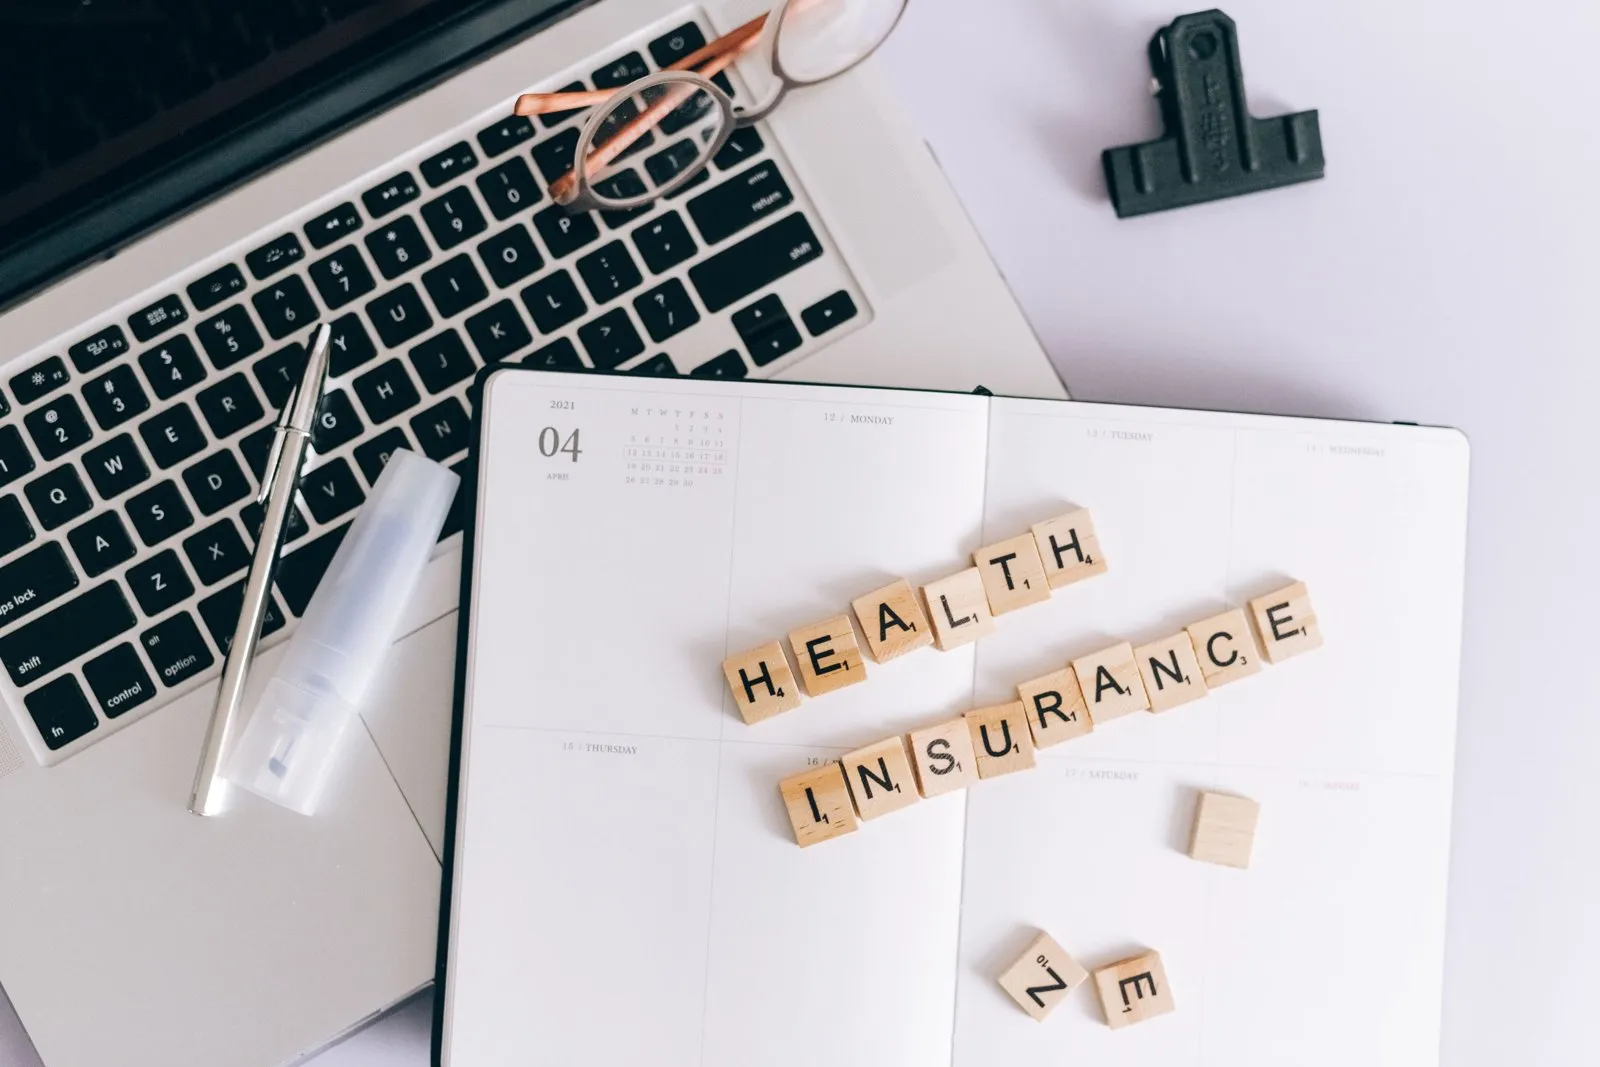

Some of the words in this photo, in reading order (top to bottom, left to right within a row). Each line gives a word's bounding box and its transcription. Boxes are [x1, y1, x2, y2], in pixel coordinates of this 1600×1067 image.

[507, 189, 520, 203] 0
[752, 191, 782, 212] return
[452, 218, 463, 232] 9
[558, 218, 571, 234] P
[396, 247, 408, 262] 8
[502, 247, 518, 263] O
[789, 241, 812, 260] shift
[329, 260, 343, 275] &
[339, 276, 349, 292] 7
[547, 295, 561, 309] L
[285, 307, 296, 321] 6
[389, 305, 406, 322] U
[214, 319, 231, 334] %
[490, 322, 506, 339] K
[227, 337, 239, 352] 5
[334, 335, 347, 351] Y
[160, 350, 172, 365] $
[439, 353, 448, 368] J
[172, 367, 182, 381] 4
[279, 367, 290, 381] T
[104, 380, 114, 394] #
[376, 381, 394, 400] H
[112, 398, 125, 412] 3
[222, 397, 236, 412] R
[550, 400, 575, 410] 2021
[45, 410, 58, 423] @
[321, 412, 337, 429] G
[824, 413, 835, 422] 12
[850, 414, 895, 425] MONDAY
[55, 428, 68, 443] 2
[165, 427, 178, 443] E
[435, 420, 451, 438] N
[1110, 430, 1154, 441] TUESDAY
[538, 426, 582, 463] 04
[104, 455, 123, 474] W
[207, 474, 222, 490] D
[547, 473, 569, 481] APRIL
[50, 489, 67, 504] Q
[323, 482, 336, 497] V
[152, 505, 164, 520] S
[96, 536, 109, 551] A
[209, 543, 224, 560] X
[1084, 554, 1093, 565] 4
[152, 573, 167, 591] Z
[1023, 579, 1031, 589] 1
[0, 601, 14, 616] ps
[13, 588, 36, 606] lock
[739, 528, 1085, 703] HEALTH
[971, 613, 979, 623] 1
[909, 622, 917, 632] 1
[1300, 625, 1307, 636] 1
[149, 635, 160, 647] alt
[18, 656, 42, 674] shift
[164, 653, 196, 677] option
[841, 660, 850, 671] 1
[1240, 656, 1247, 665] 3
[1183, 674, 1191, 685] 1
[107, 682, 142, 708] control
[776, 687, 785, 698] 4
[1124, 684, 1132, 696] 1
[805, 601, 1300, 823] INSURANCE
[1069, 711, 1077, 721] 1
[52, 725, 64, 738] fn
[563, 742, 574, 750] 15
[586, 743, 637, 755] THURSDAY
[1012, 742, 1020, 753] 1
[807, 757, 819, 766] 16
[955, 760, 963, 772] 1
[1089, 770, 1140, 781] SATURDAY
[894, 783, 902, 793] 1
[821, 813, 830, 824] 1
[1036, 954, 1049, 968] 10
[1025, 966, 1068, 1008] Z
[1119, 971, 1157, 1006] E
